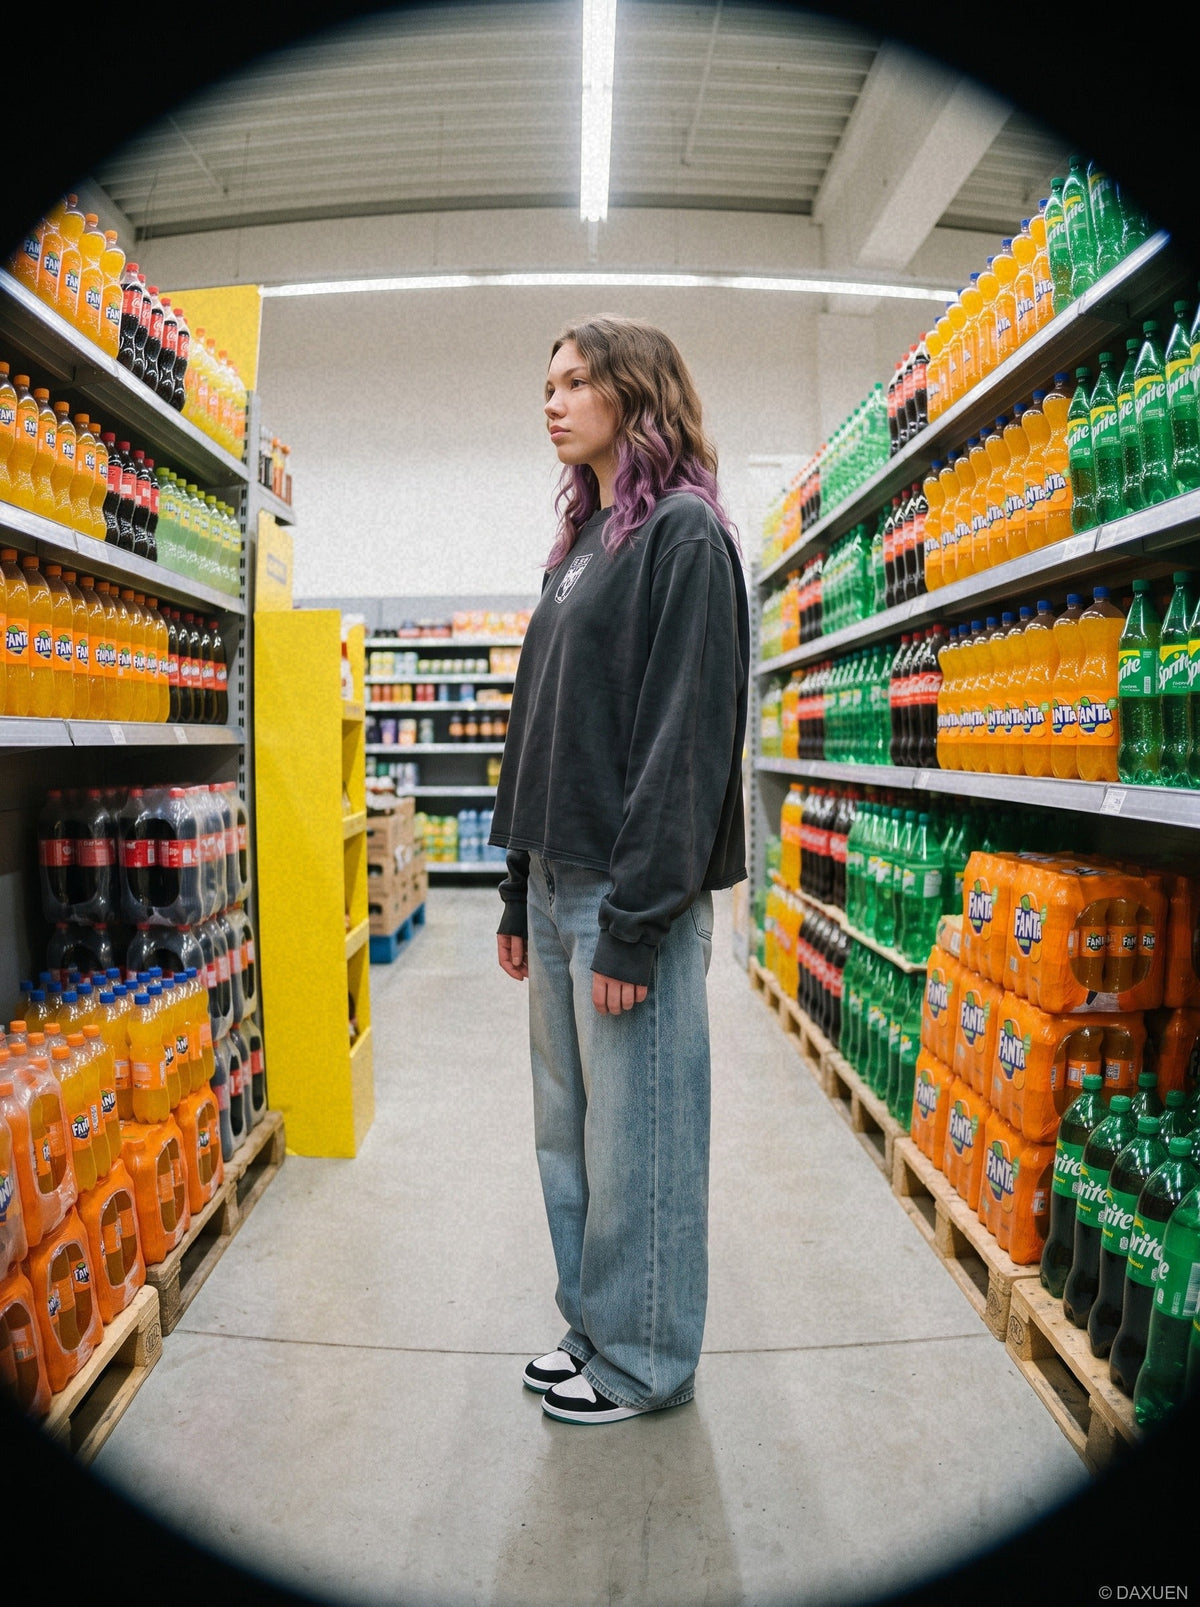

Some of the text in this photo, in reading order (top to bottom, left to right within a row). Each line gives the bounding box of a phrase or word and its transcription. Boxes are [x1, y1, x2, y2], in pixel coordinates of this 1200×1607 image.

[1053, 705, 1078, 723] NTA
[968, 891, 993, 919] FANTA
[1014, 907, 1042, 939] FANTA
[928, 979, 948, 1008] FANTA
[961, 1001, 985, 1035] FANTA
[999, 1030, 1026, 1068] FANTA
[916, 1079, 937, 1111] FANTA
[950, 1108, 973, 1146] FANTA
[986, 1150, 1014, 1193] FANTA
[1078, 1180, 1107, 1204] rite
[1105, 1203, 1134, 1230] rite
